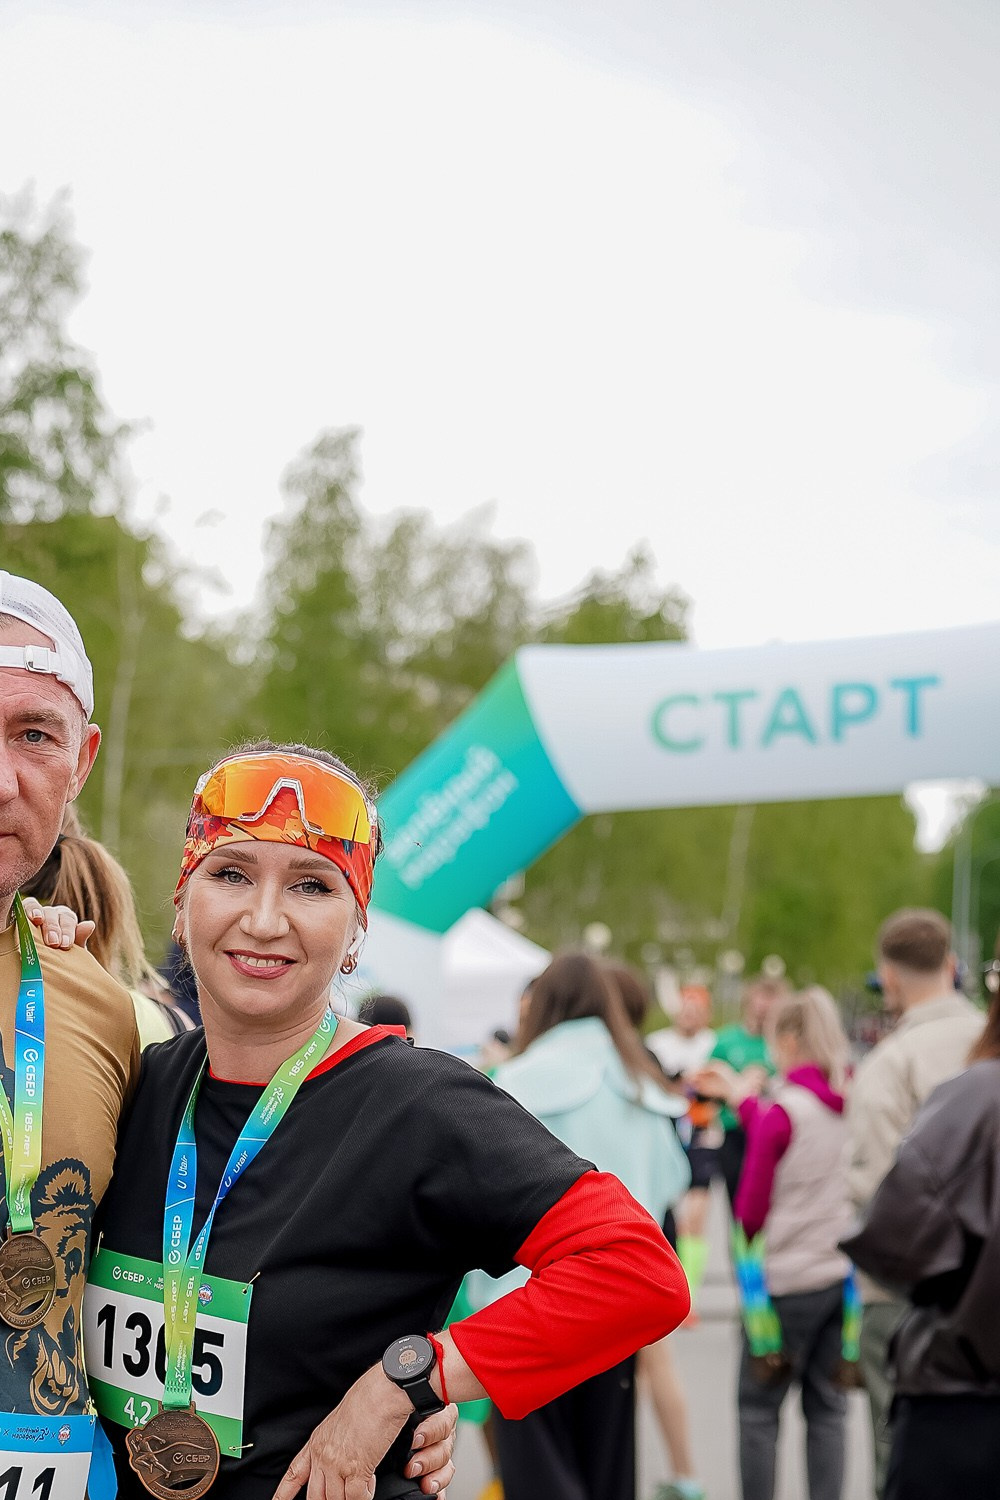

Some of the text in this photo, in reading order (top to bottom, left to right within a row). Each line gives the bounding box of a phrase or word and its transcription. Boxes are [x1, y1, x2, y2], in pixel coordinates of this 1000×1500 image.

[649, 674, 942, 753] СТАРТ
[26, 1001, 36, 1023] Utair
[288, 1041, 318, 1077] 185 лет
[25, 1064, 36, 1097] СБЕР
[23, 1111, 33, 1157] 185 лет
[178, 1154, 189, 1177] Utair
[233, 1150, 249, 1174] Utair
[171, 1215, 183, 1248] СБЕР
[122, 1270, 145, 1284] СБЕР
[186, 1276, 195, 1297] 185
[124, 1396, 152, 1427] 4,2
